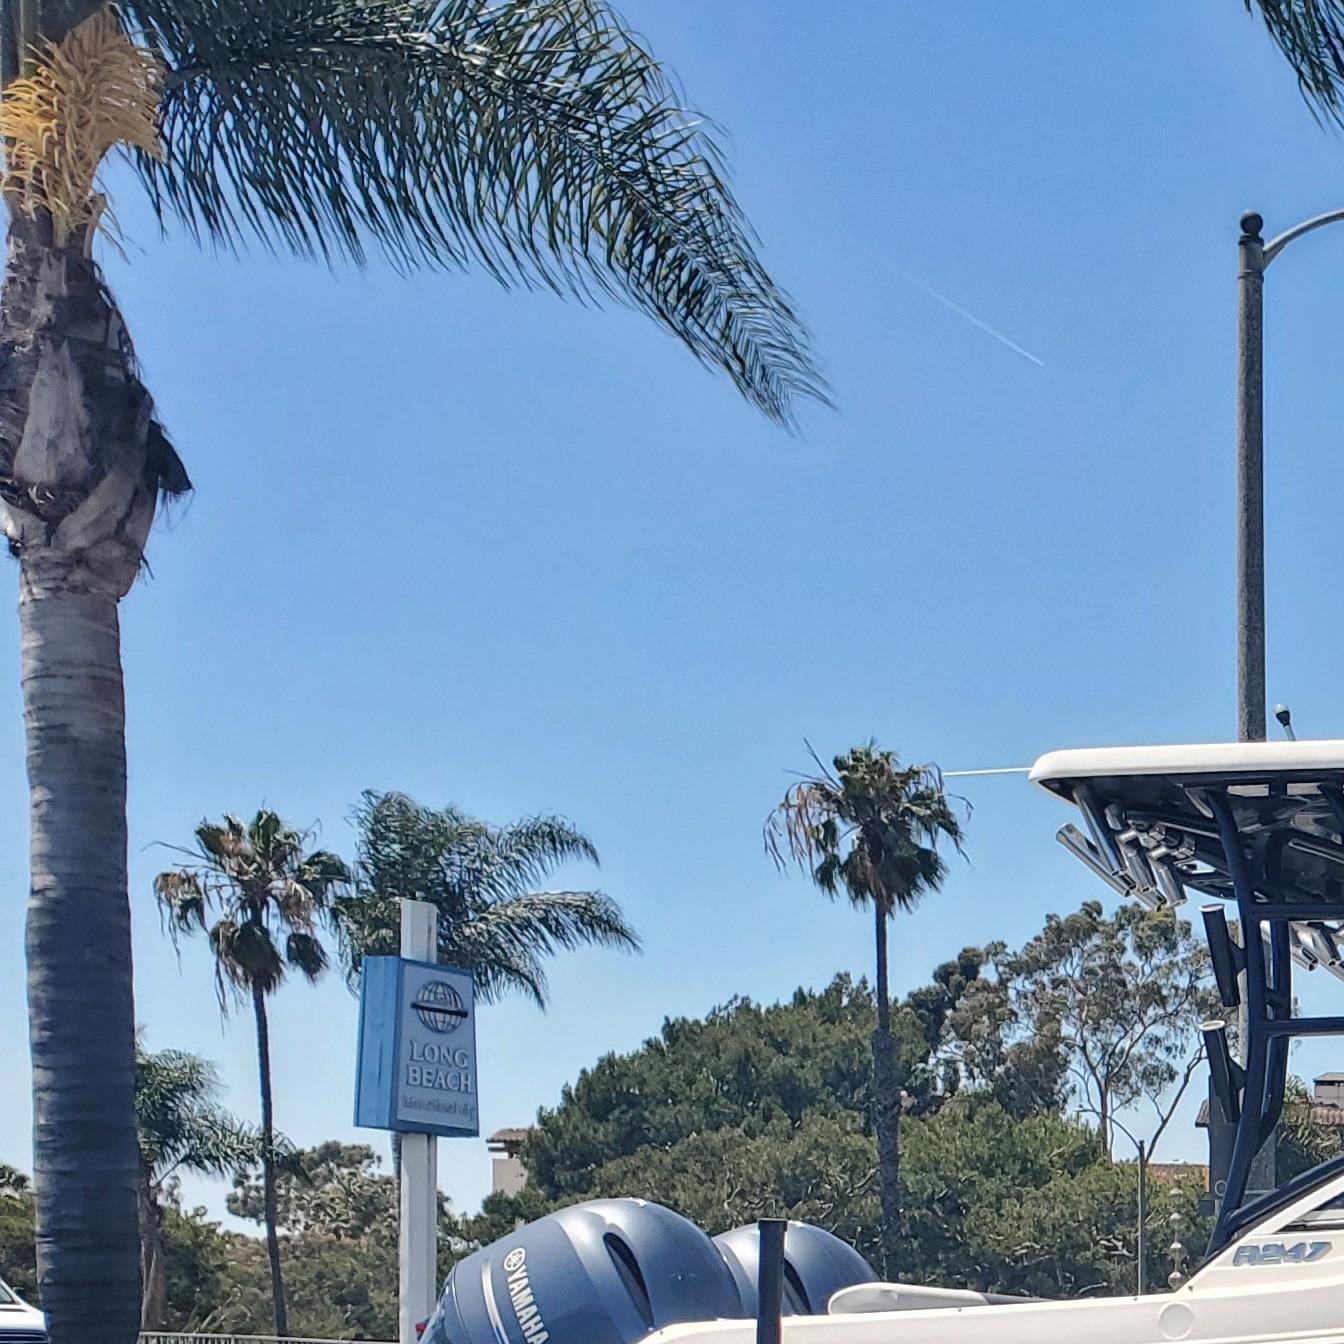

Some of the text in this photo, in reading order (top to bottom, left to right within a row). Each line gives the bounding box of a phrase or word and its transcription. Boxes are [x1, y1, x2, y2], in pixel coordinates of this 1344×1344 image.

[410, 1039, 469, 1069] LONG
[405, 1064, 474, 1096] BEACH
[1232, 1241, 1332, 1267] R247
